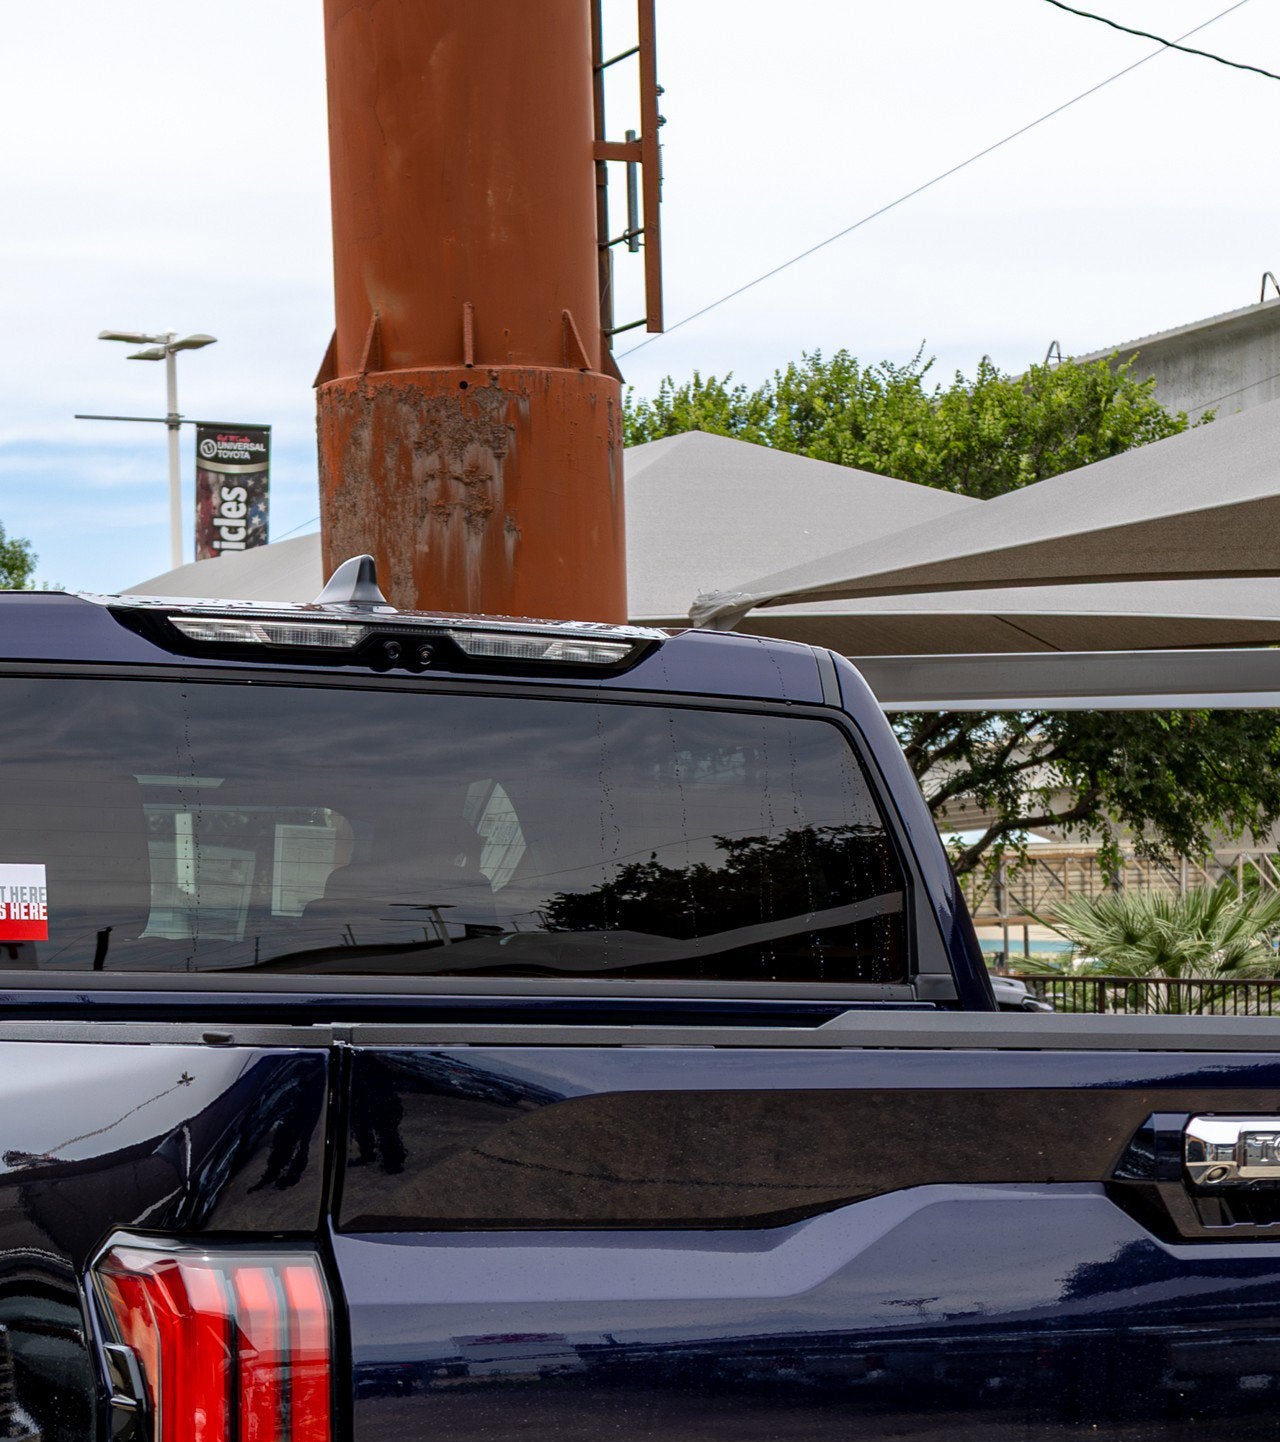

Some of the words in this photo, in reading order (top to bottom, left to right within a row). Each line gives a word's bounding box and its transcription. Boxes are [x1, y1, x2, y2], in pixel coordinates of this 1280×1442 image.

[218, 442, 266, 452] UNIVERSAL
[218, 450, 251, 459] TOYOTA
[213, 486, 248, 554] icles
[10, 886, 47, 904] HERE
[10, 903, 48, 921] HERE
